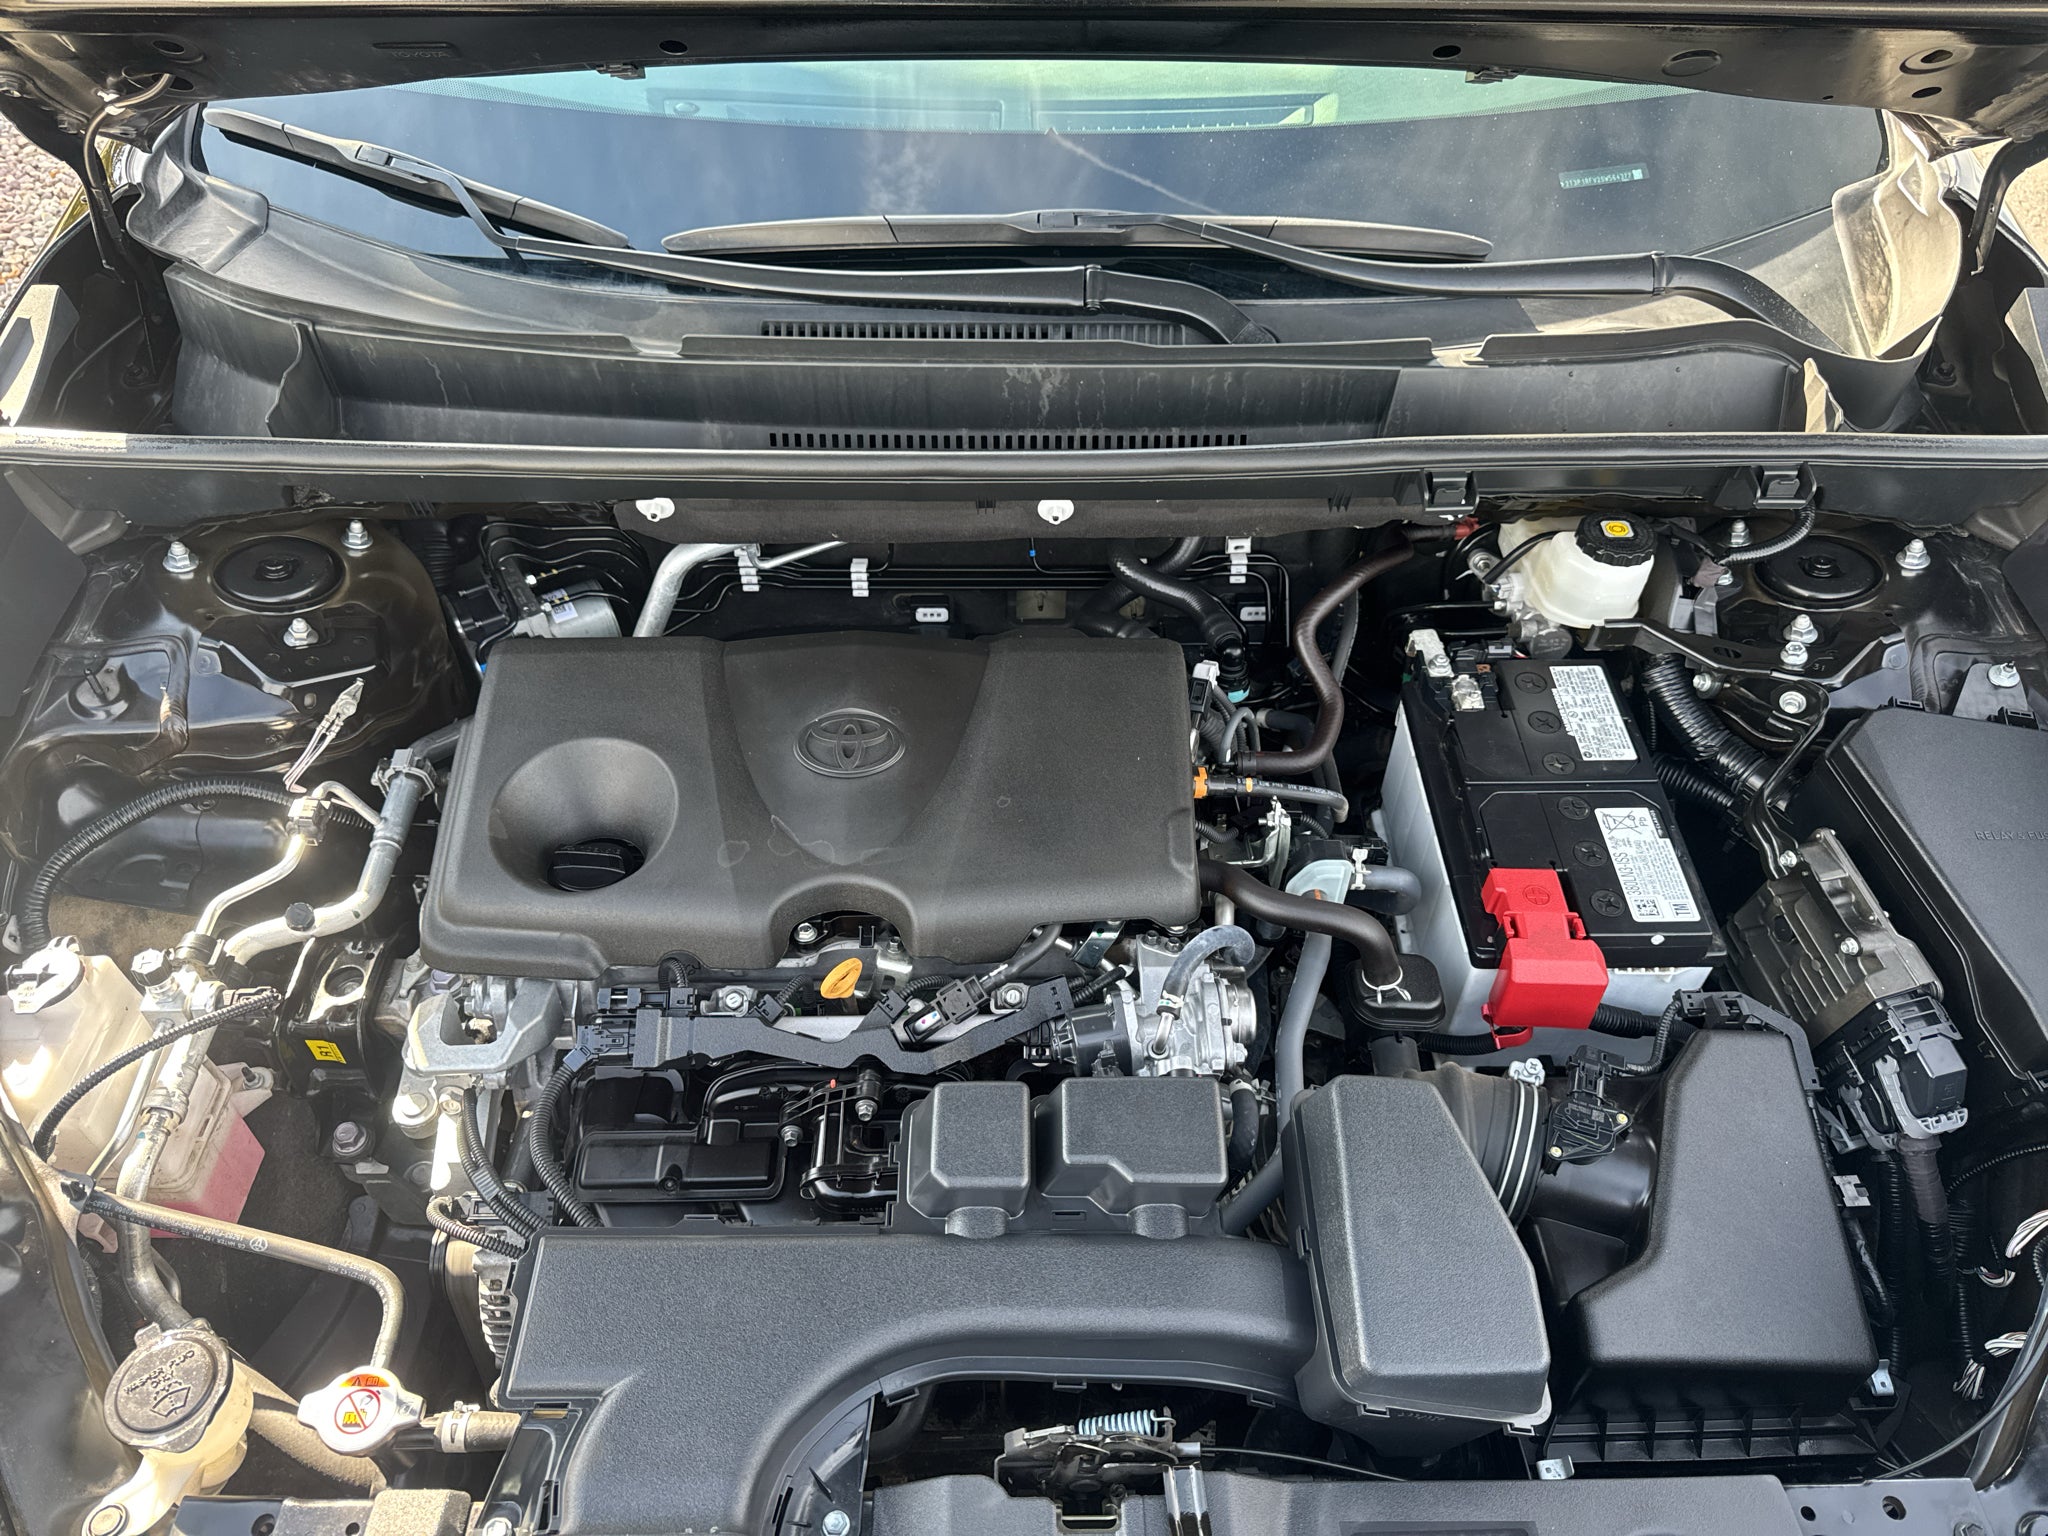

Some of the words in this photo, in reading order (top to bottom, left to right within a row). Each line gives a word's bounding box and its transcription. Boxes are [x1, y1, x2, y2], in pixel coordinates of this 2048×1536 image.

[1638, 816, 1649, 827] Pb
[1974, 830, 2014, 840] RELAY
[1672, 903, 1690, 916] TM
